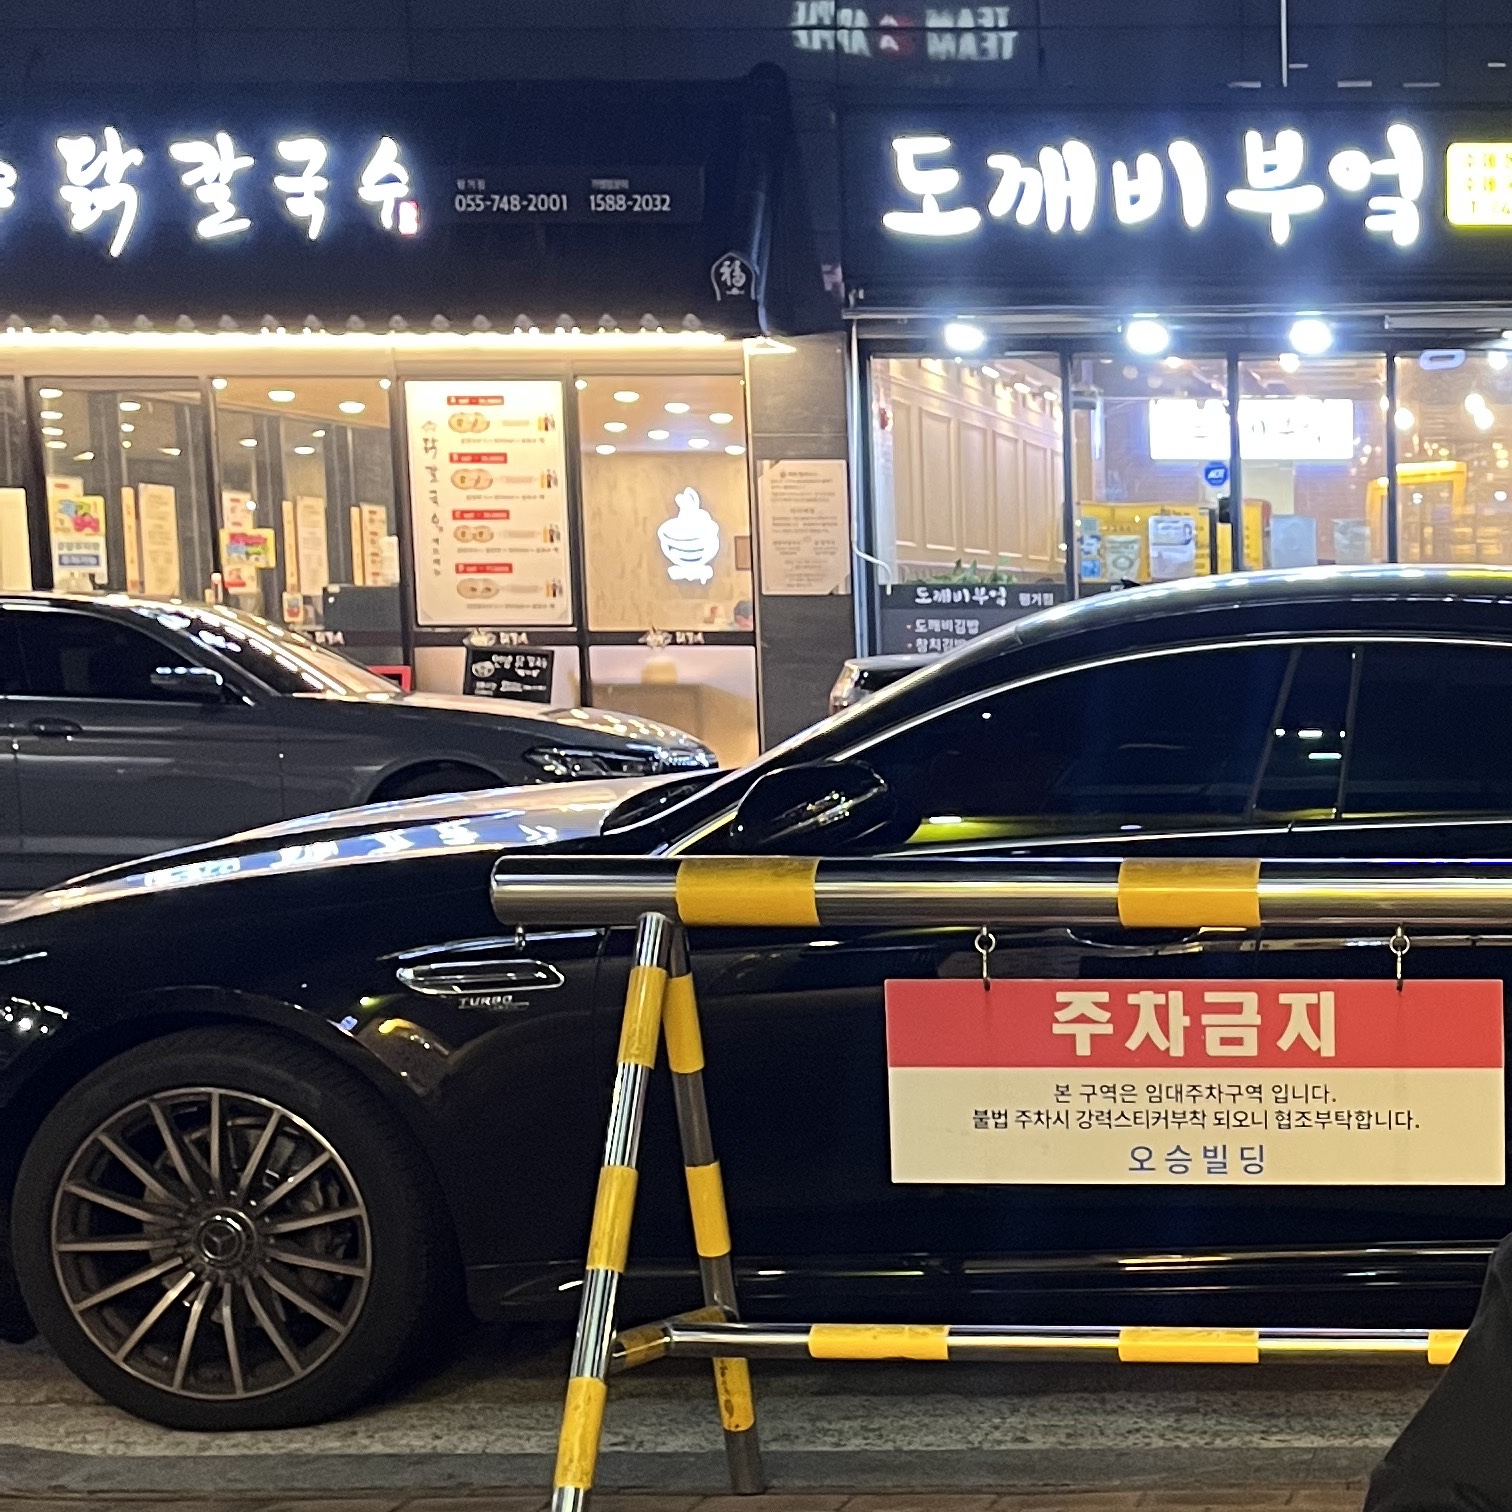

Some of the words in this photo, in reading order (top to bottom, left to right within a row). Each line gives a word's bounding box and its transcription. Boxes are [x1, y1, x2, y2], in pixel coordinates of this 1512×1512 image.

[0, 125, 409, 257] 닭칼국수
[882, 122, 1425, 247] 도깨비부엌
[455, 194, 568, 212] 055-748-2001
[590, 194, 672, 212] 1588-2032
[720, 260, 747, 288] 福
[1051, 989, 1336, 1058] 주차금지
[1053, 1083, 1073, 1104] 본
[1079, 1083, 1138, 1104] 구역은
[1145, 1083, 1264, 1104] 임대주차구역
[1271, 1083, 1337, 1104] 입니다.
[972, 1109, 1008, 1130] 불법
[1014, 1109, 1070, 1131] 주차시
[1076, 1109, 1207, 1131] 강력스티커부착
[1212, 1109, 1269, 1131] 되오니
[1274, 1109, 1420, 1131] 협조부탁합니다.
[1128, 1144, 1267, 1176] 오승빌딩
